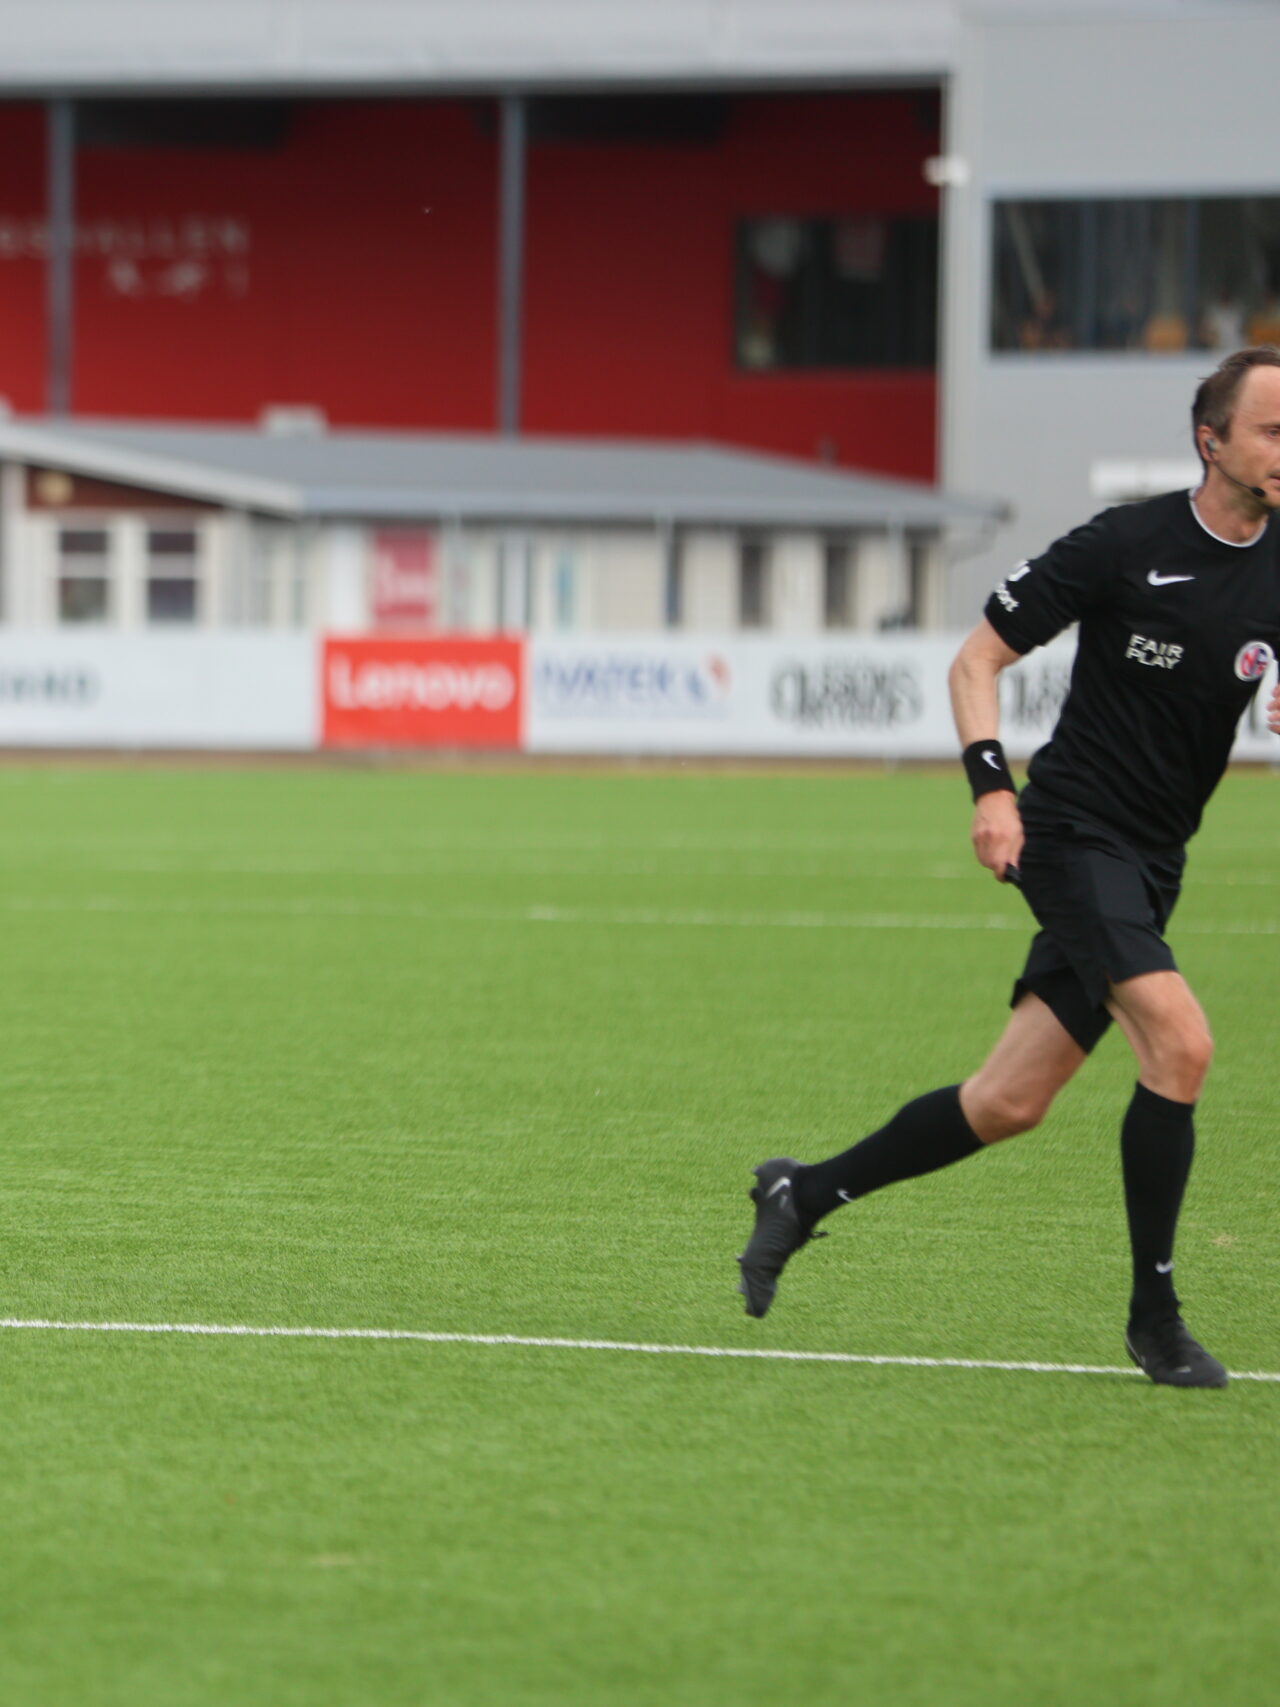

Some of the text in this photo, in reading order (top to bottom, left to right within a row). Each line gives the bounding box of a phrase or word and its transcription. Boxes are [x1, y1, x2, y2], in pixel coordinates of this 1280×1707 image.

[1125, 646, 1181, 670] PLAY
[1129, 633, 1185, 658] FAIR
[328, 652, 516, 711] Lenovo
